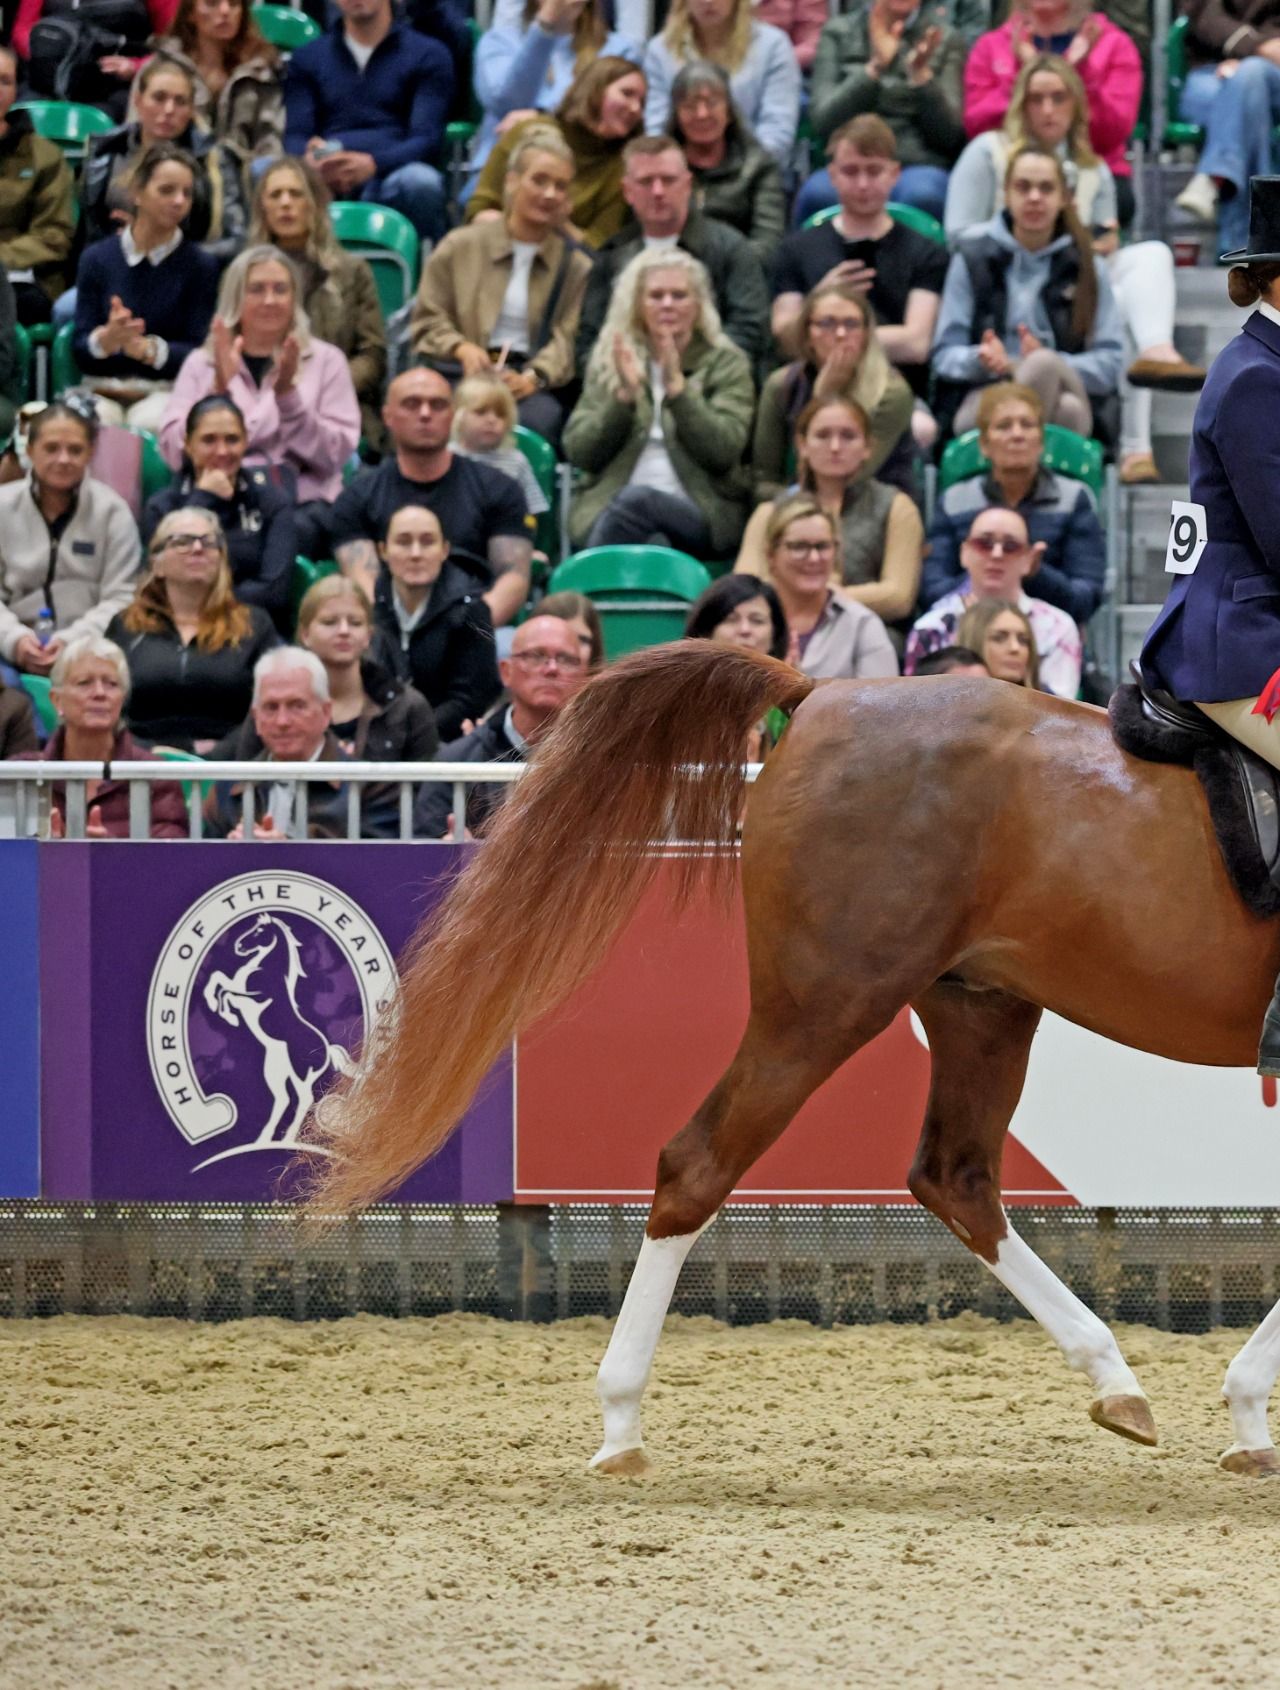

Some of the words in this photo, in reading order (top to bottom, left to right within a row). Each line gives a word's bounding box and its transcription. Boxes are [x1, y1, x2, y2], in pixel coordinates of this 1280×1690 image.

[1170, 513, 1198, 563] 9
[161, 983, 192, 1105] HORSE
[178, 920, 208, 960] OF
[221, 884, 291, 911] THE
[317, 896, 381, 975] YEAR
